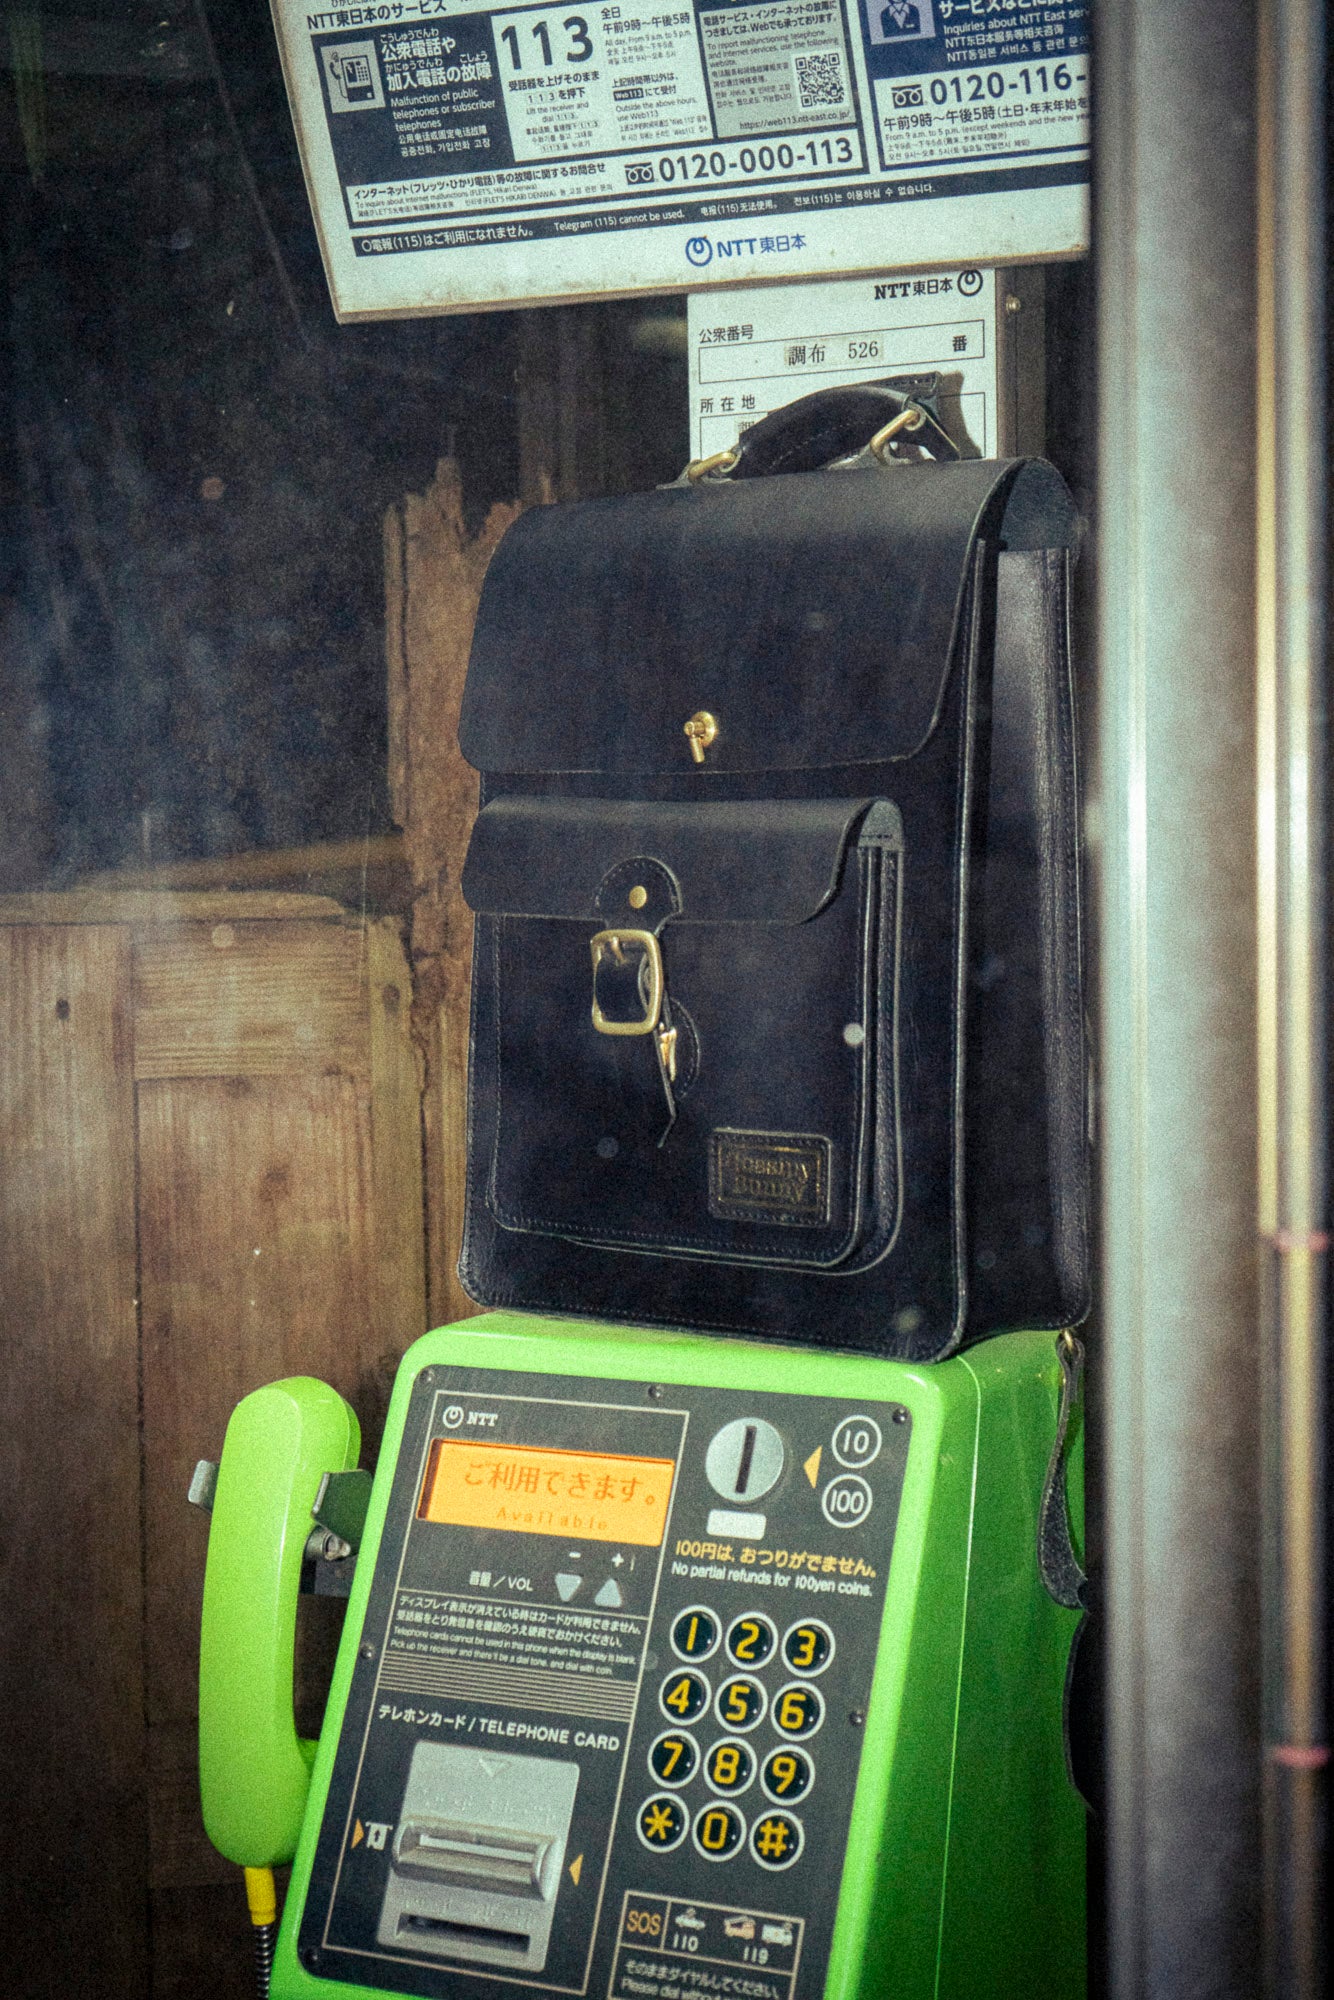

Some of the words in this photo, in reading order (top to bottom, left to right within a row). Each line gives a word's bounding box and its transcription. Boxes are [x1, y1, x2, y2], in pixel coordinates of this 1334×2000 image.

[600, 6, 621, 20] 全日
[943, 21, 985, 35] Inquiries
[988, 18, 1017, 29] about
[1020, 13, 1041, 25] NTT
[1044, 10, 1066, 21] East
[381, 37, 456, 62] 公衆電話や
[501, 16, 595, 71] 113
[740, 34, 789, 46] malfunctioning
[387, 62, 492, 92] 加入電話の故障
[508, 70, 600, 91] 受話器を上げそのまま
[391, 93, 440, 107] Malfunction
[442, 91, 451, 101] of
[452, 88, 479, 102] public
[393, 106, 439, 120] telephones
[441, 106, 449, 114] or
[453, 100, 496, 112] subscriber
[395, 119, 442, 132] telephones
[885, 131, 904, 141] From
[990, 120, 1026, 130] weekends
[1028, 117, 1043, 126] and
[658, 137, 853, 182] 0120-000-113
[554, 218, 593, 232] Telegram
[594, 216, 618, 228] (115)
[619, 212, 648, 223] cannot
[650, 211, 660, 220] be
[662, 209, 685, 219] used.
[717, 233, 807, 258] NTT東日本
[874, 277, 953, 300] NTT東日本
[700, 324, 754, 344] 公衆番号
[952, 335, 968, 352] 番
[787, 344, 826, 367] 調布
[848, 341, 879, 360] 526
[700, 394, 756, 414] 所在地
[466, 1412, 498, 1427] NTT
[843, 1429, 870, 1454] 10
[830, 1489, 865, 1514] 100
[497, 1507, 608, 1530] Available
[508, 1578, 534, 1592] VOL
[672, 1561, 688, 1576] No
[690, 1565, 726, 1581] partial
[727, 1569, 772, 1585] refunds
[774, 1573, 790, 1587] for
[794, 1575, 836, 1594] 100yen
[838, 1581, 873, 1597] coins.
[394, 1626, 429, 1640] Telephone
[430, 1630, 449, 1641] cards
[450, 1633, 474, 1644] cannot
[474, 1636, 485, 1646] be
[485, 1638, 503, 1648] used
[525, 1643, 548, 1654] phone
[549, 1646, 568, 1656] when
[569, 1648, 581, 1658] the
[582, 1650, 607, 1662] display
[686, 1616, 698, 1651] 1
[735, 1622, 760, 1660] 2
[792, 1629, 816, 1666] 3
[416, 1643, 428, 1652] the
[429, 1645, 458, 1656] receiver
[459, 1649, 473, 1657] and
[516, 1656, 530, 1665] dial
[550, 1660, 565, 1670] and
[565, 1661, 579, 1671] dial
[580, 1663, 595, 1673] with
[666, 1678, 691, 1714] 4
[725, 1685, 750, 1721] 5
[780, 1692, 806, 1729] 6
[379, 1705, 467, 1730] テレホンカード
[479, 1718, 569, 1744] TELEPHONE
[574, 1732, 620, 1751] CARD
[662, 1741, 684, 1778] 7
[713, 1747, 740, 1784] 8
[772, 1756, 797, 1794] 9
[702, 1811, 728, 1849] 0
[626, 1910, 662, 1936] SOS
[673, 1932, 699, 1952] 110
[743, 1946, 769, 1965] 119
[621, 1977, 659, 1995] Please
